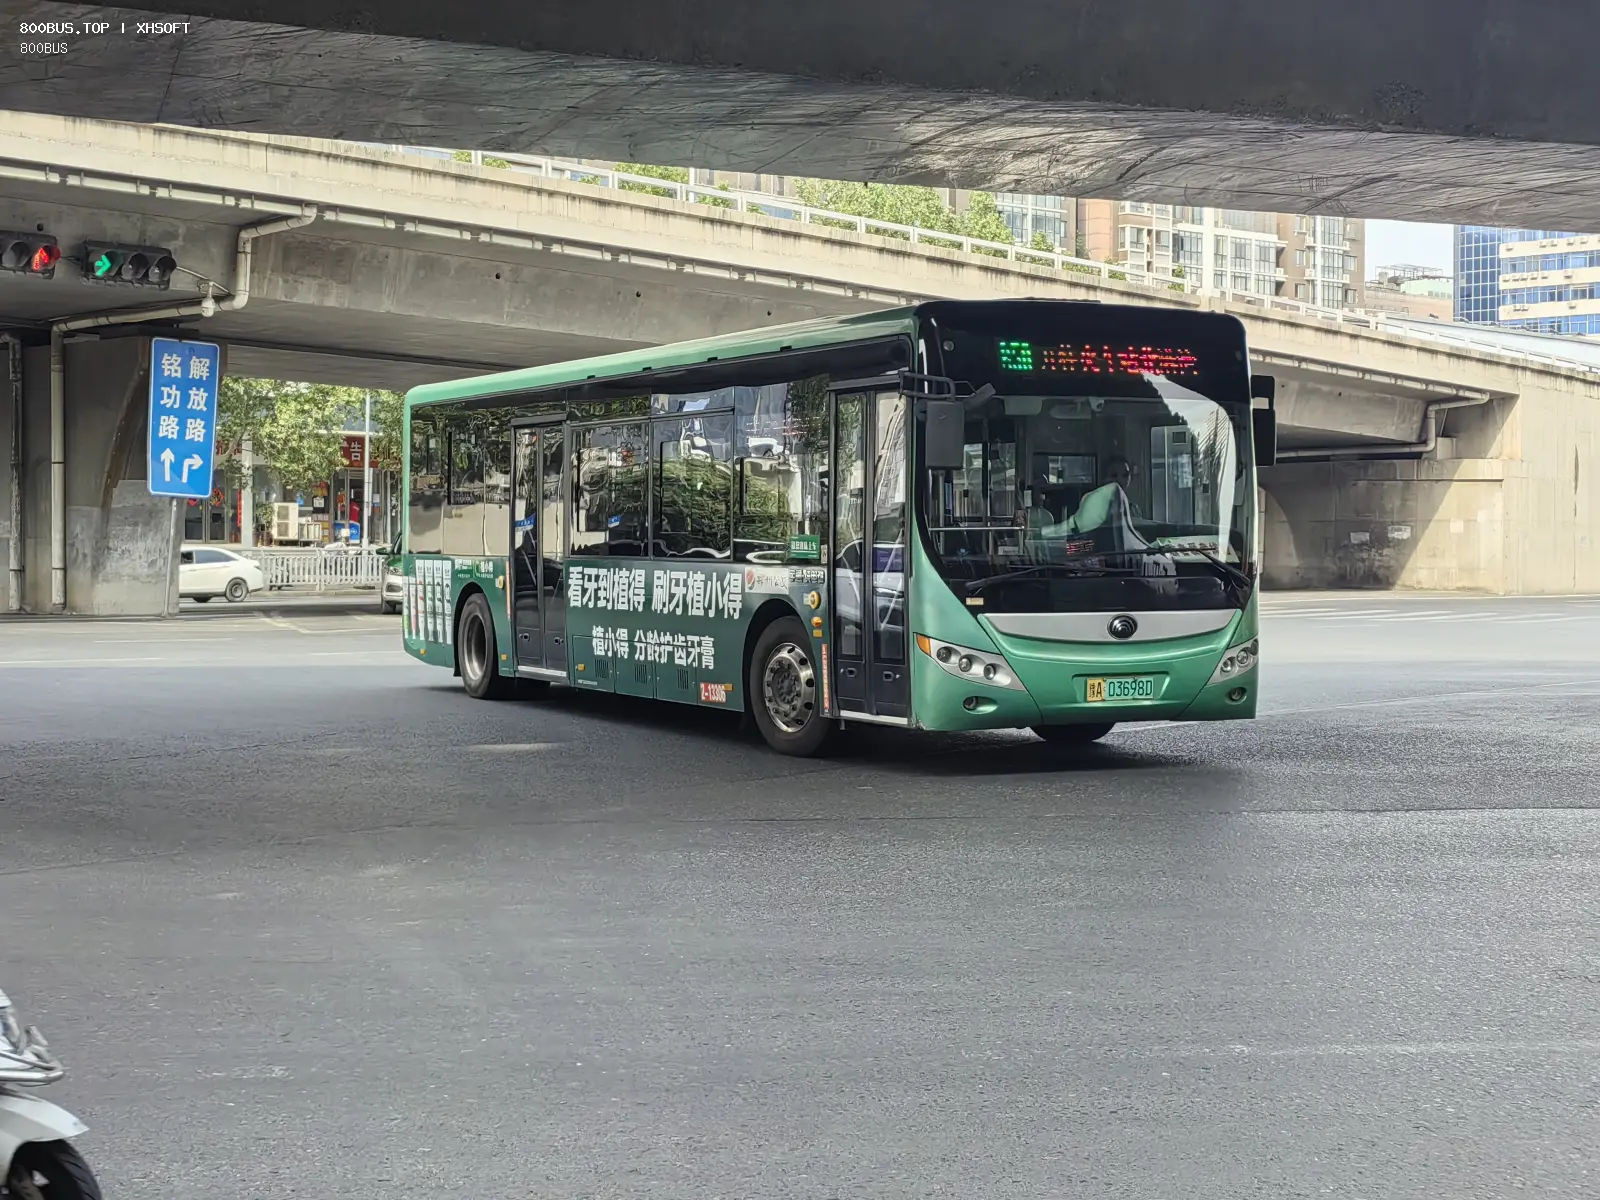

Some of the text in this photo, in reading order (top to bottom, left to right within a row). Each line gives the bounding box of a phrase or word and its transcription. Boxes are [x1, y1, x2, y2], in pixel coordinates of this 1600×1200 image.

[158, 353, 181, 440] 铭功路
[185, 356, 210, 442] 解放路
[568, 566, 743, 619] 看牙到植得 刷牙植小得
[592, 625, 715, 669] 植小得 分龄护齿牙膏
